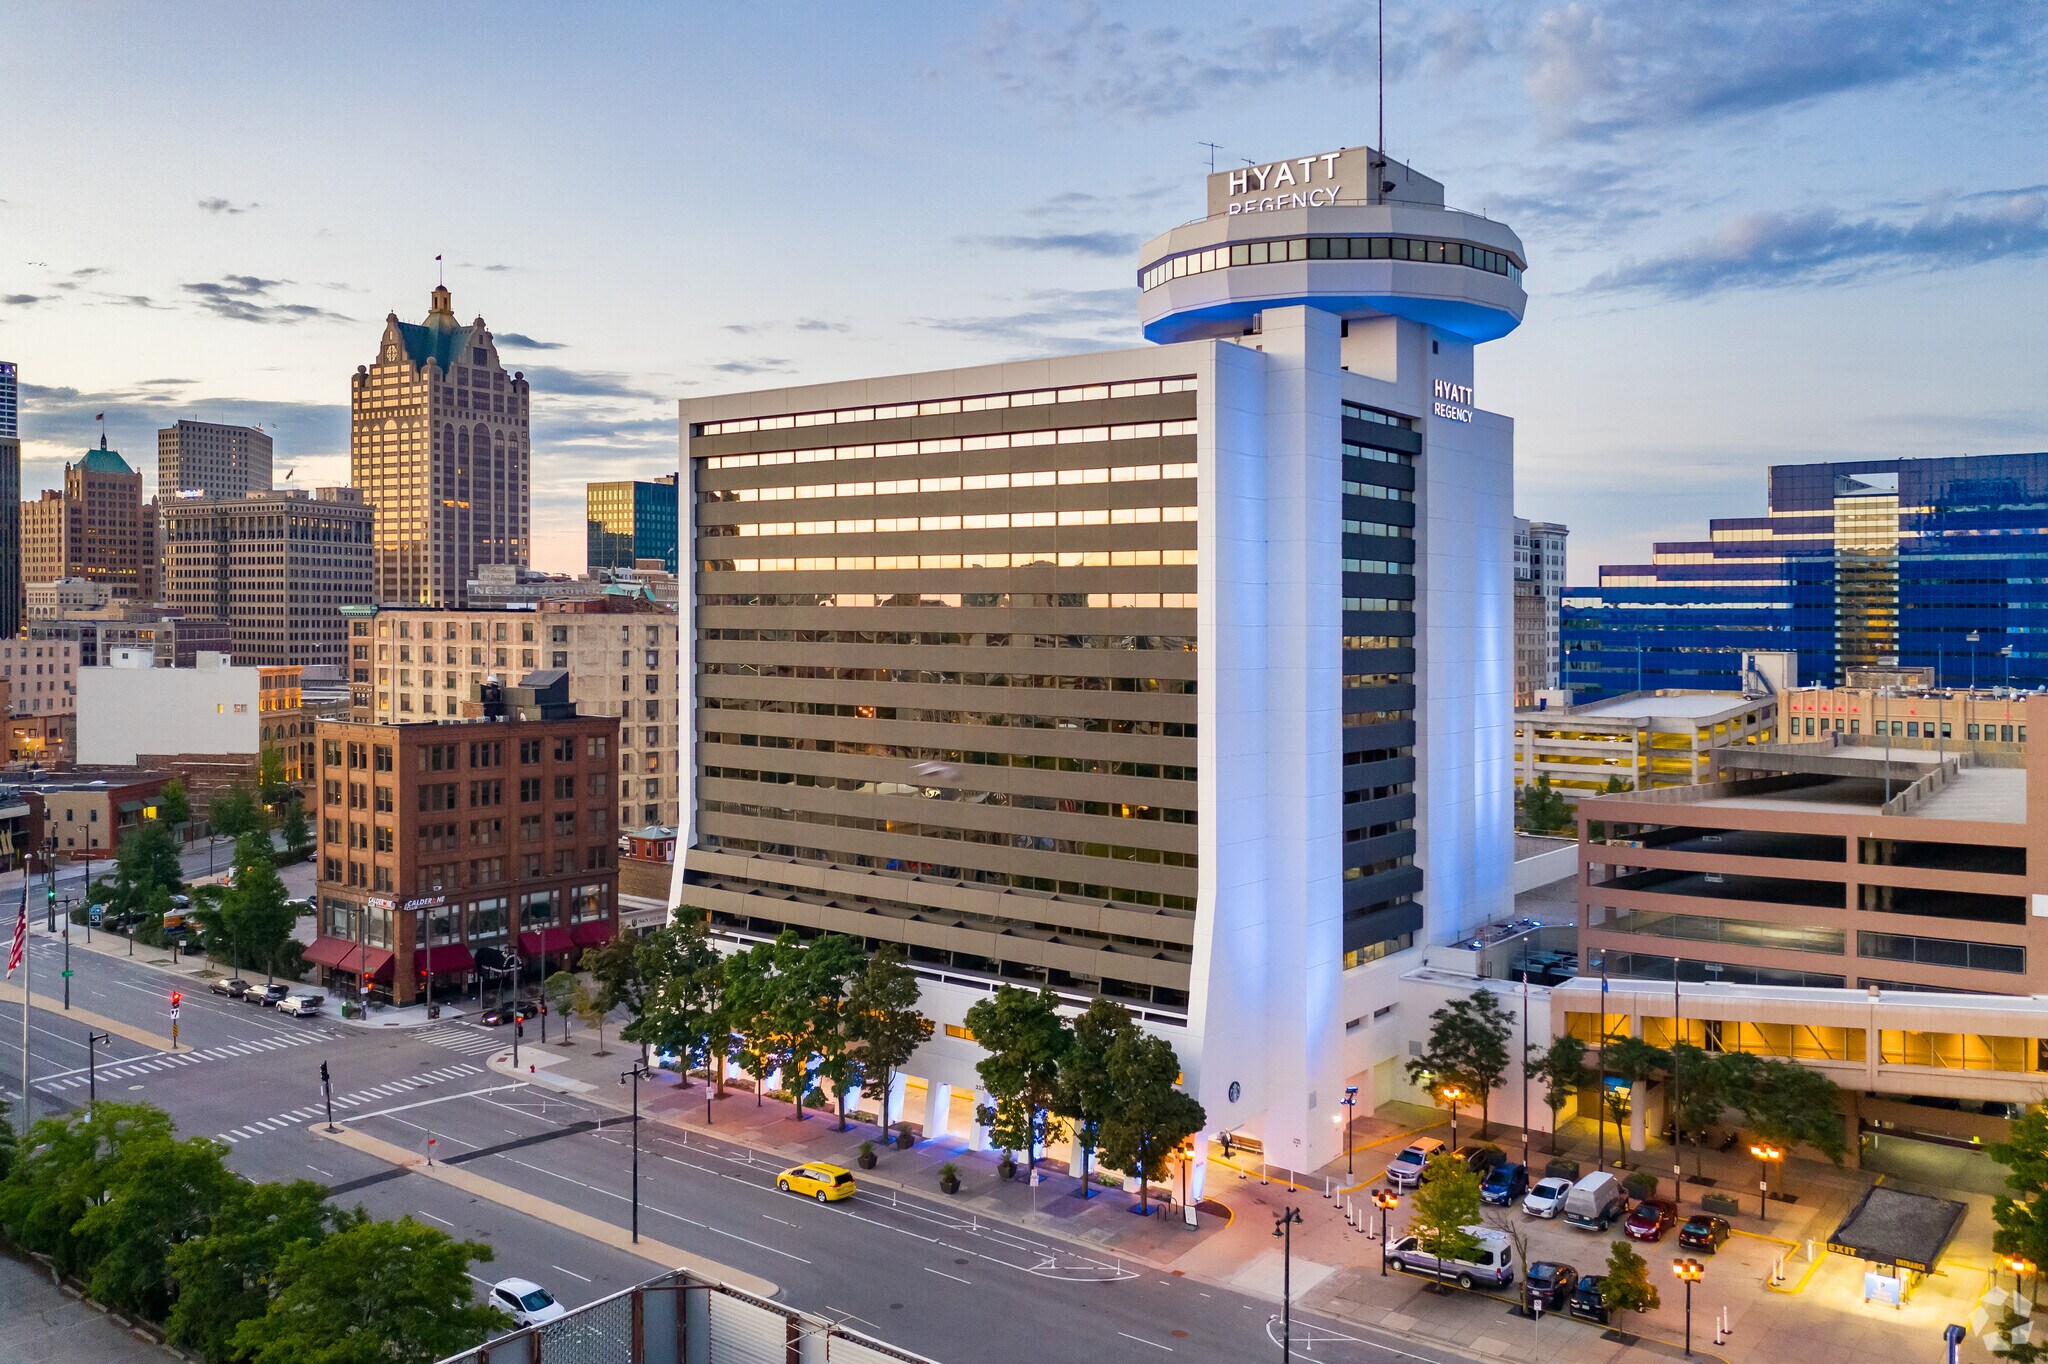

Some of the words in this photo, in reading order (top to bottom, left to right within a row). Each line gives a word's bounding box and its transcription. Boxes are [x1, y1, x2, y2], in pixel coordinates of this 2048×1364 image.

[1229, 152, 1342, 196] HYATT
[1229, 185, 1342, 216] REGENCY
[1434, 378, 1473, 406] HYATT
[1434, 402, 1473, 424] REGENCY
[1828, 1243, 1857, 1256] EXIT
